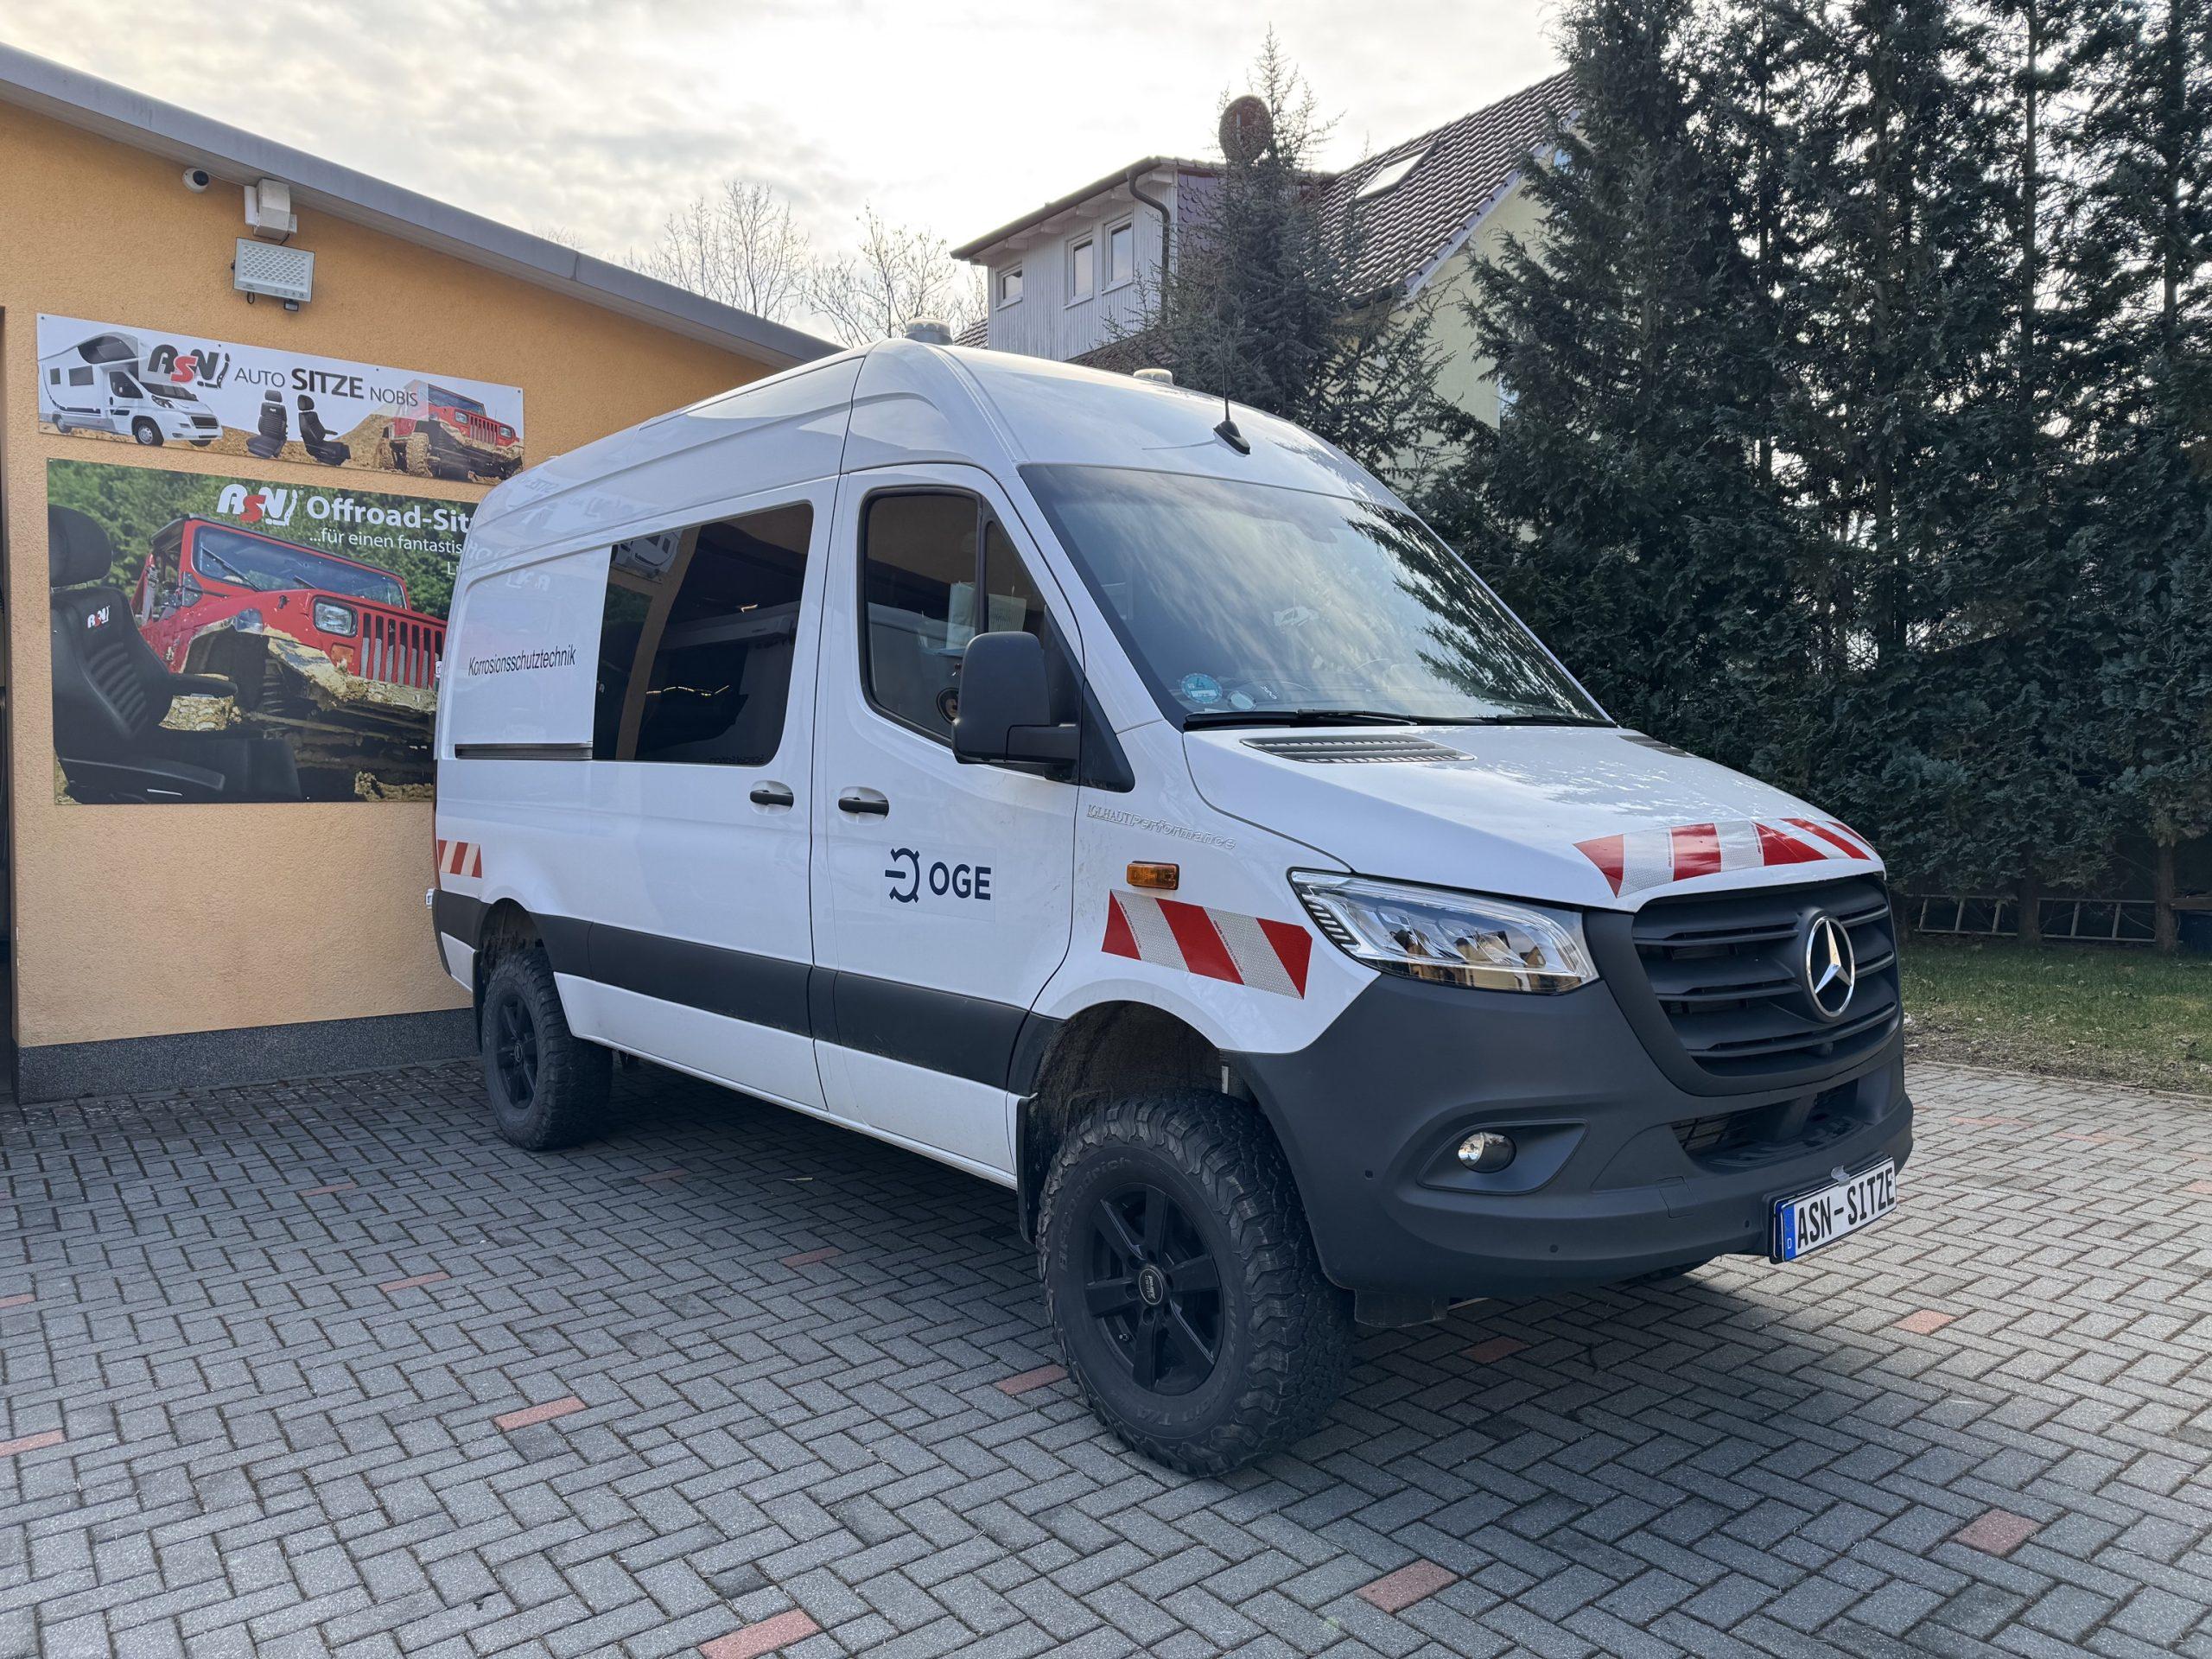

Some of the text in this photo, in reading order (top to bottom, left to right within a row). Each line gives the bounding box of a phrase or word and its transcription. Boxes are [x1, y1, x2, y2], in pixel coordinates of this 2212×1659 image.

[147, 344, 418, 407] ASN AUTO SITZE NOBIS
[306, 495, 474, 533] Offroad-Sit
[349, 531, 394, 549] einen
[467, 644, 576, 677] Korrosionsschutztechnik
[1131, 813, 1237, 850] Performance
[929, 861, 991, 900] OGE
